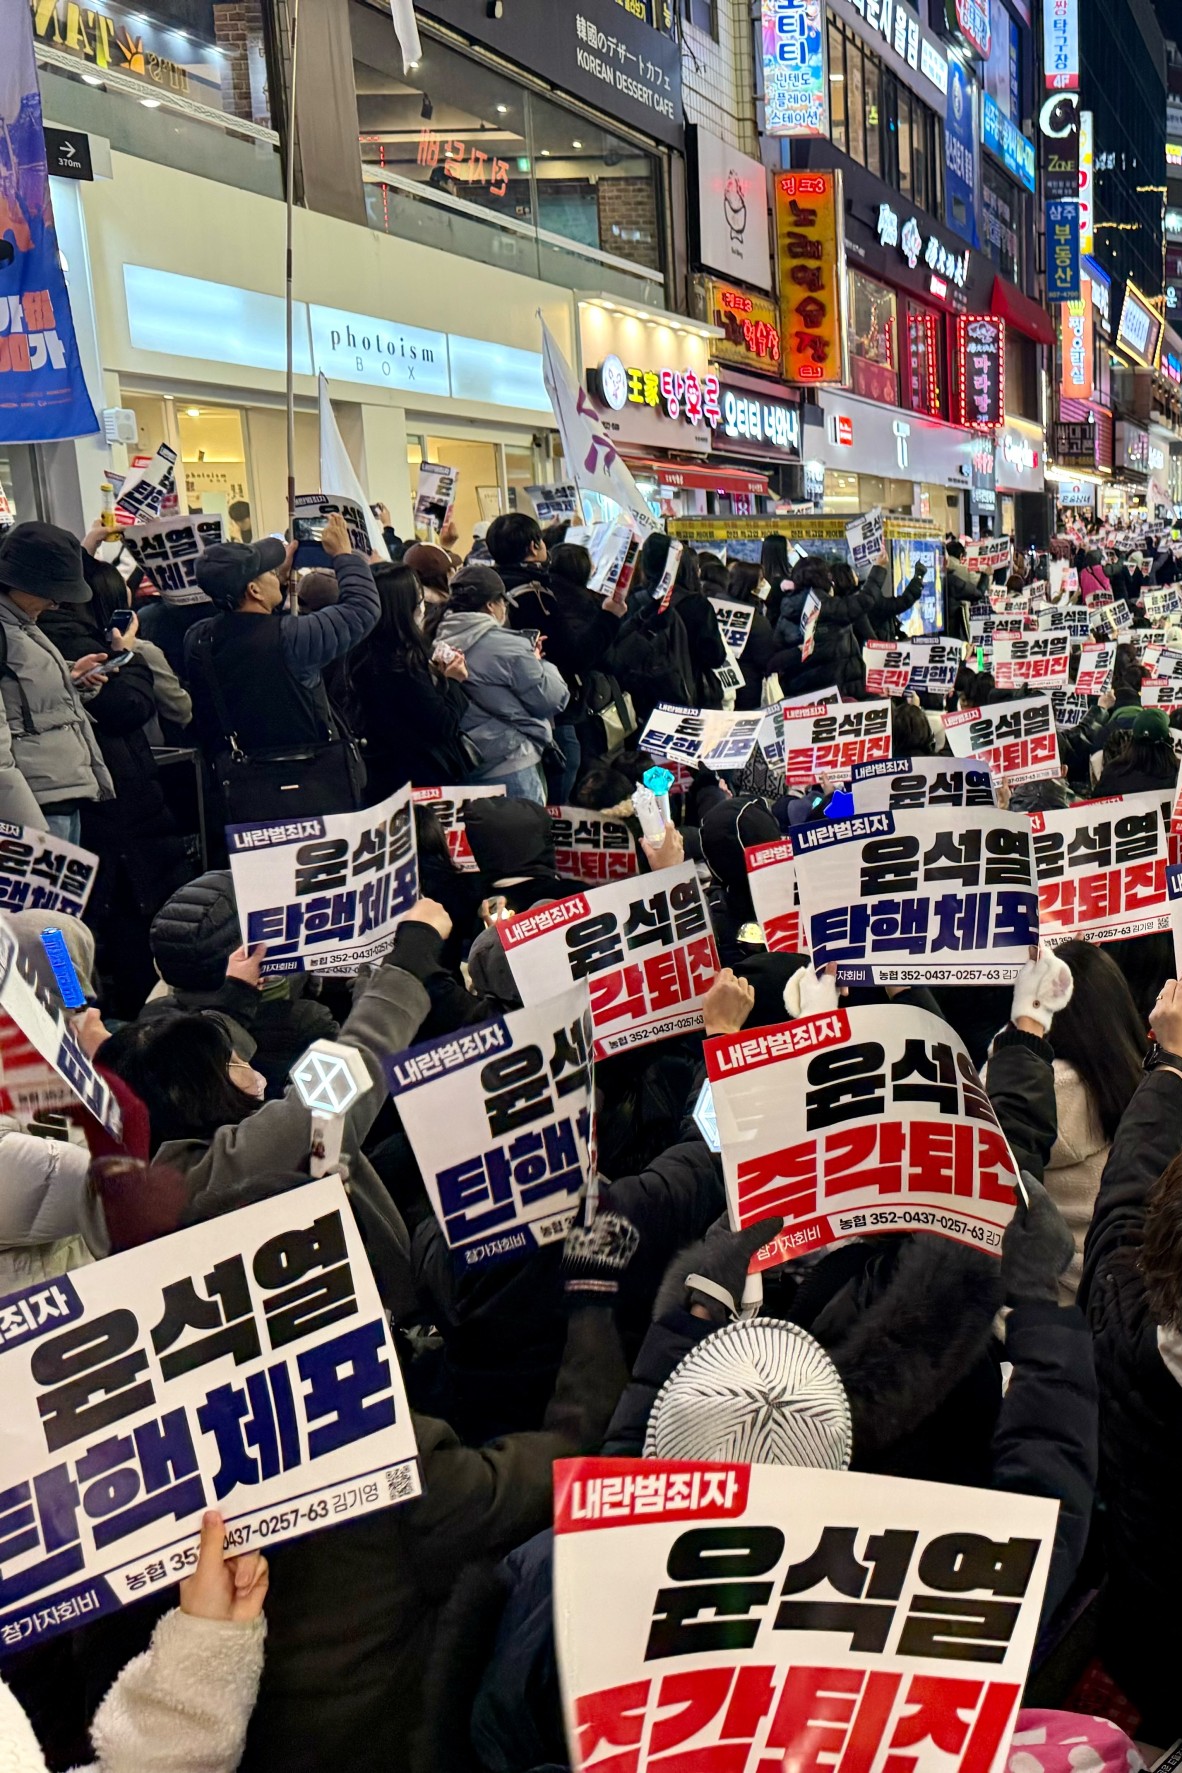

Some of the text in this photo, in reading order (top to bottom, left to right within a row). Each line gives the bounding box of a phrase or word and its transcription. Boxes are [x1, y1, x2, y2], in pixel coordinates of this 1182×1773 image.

[1053, 19, 1068, 70] 탁구장
[576, 47, 675, 120] KOREAN DESSERT CAFE
[775, 72, 811, 87] 닌텐도
[776, 91, 812, 106] 플레이
[1052, 73, 1070, 89] 4F
[770, 109, 819, 127] 스테이션
[58, 157, 82, 169] 370m
[1048, 155, 1076, 172] ZONE
[1050, 204, 1077, 221] 삼주
[1054, 224, 1073, 288] 부동산
[331, 325, 434, 363] photoism
[356, 356, 415, 380] BOX
[725, 391, 799, 448] 오티티 너와나
[994, 656, 1069, 679] 즉각퇴진
[1010, 636, 1068, 659] 윤석열
[811, 708, 889, 744] 윤석열
[968, 703, 1050, 751] 윤석열
[786, 734, 891, 774] 즉각퇴진
[855, 759, 909, 779] 내란범죄자
[888, 769, 994, 811] 윤석열
[233, 820, 322, 848] 내란범죄자
[294, 801, 414, 897] 윤석열
[551, 818, 629, 850] 윤석열
[798, 814, 889, 850] 내란범죄자
[1033, 810, 1158, 879] 윤석열
[860, 827, 1033, 898] 윤석열
[504, 896, 586, 944] 내란범죄자
[565, 876, 707, 981] 윤석열
[810, 890, 1040, 972] 탄핵체포
[879, 970, 1001, 981] 농협 352-0437-0257-63
[394, 1021, 506, 1089] 내란범죄자
[609, 1034, 629, 1048] 농협
[715, 1014, 842, 1073] 내란범죄자
[736, 1120, 1019, 1232] 즉각퇴진
[838, 1213, 867, 1231] 농협
[869, 1209, 985, 1242] 352-0437-0257-63
[29, 1208, 360, 1454] 윤석열
[571, 1470, 739, 1521] 내란범죄자
[0, 1481, 381, 1647] 참가자회비 농협 김기영
[643, 1525, 1041, 1665] 윤석열
